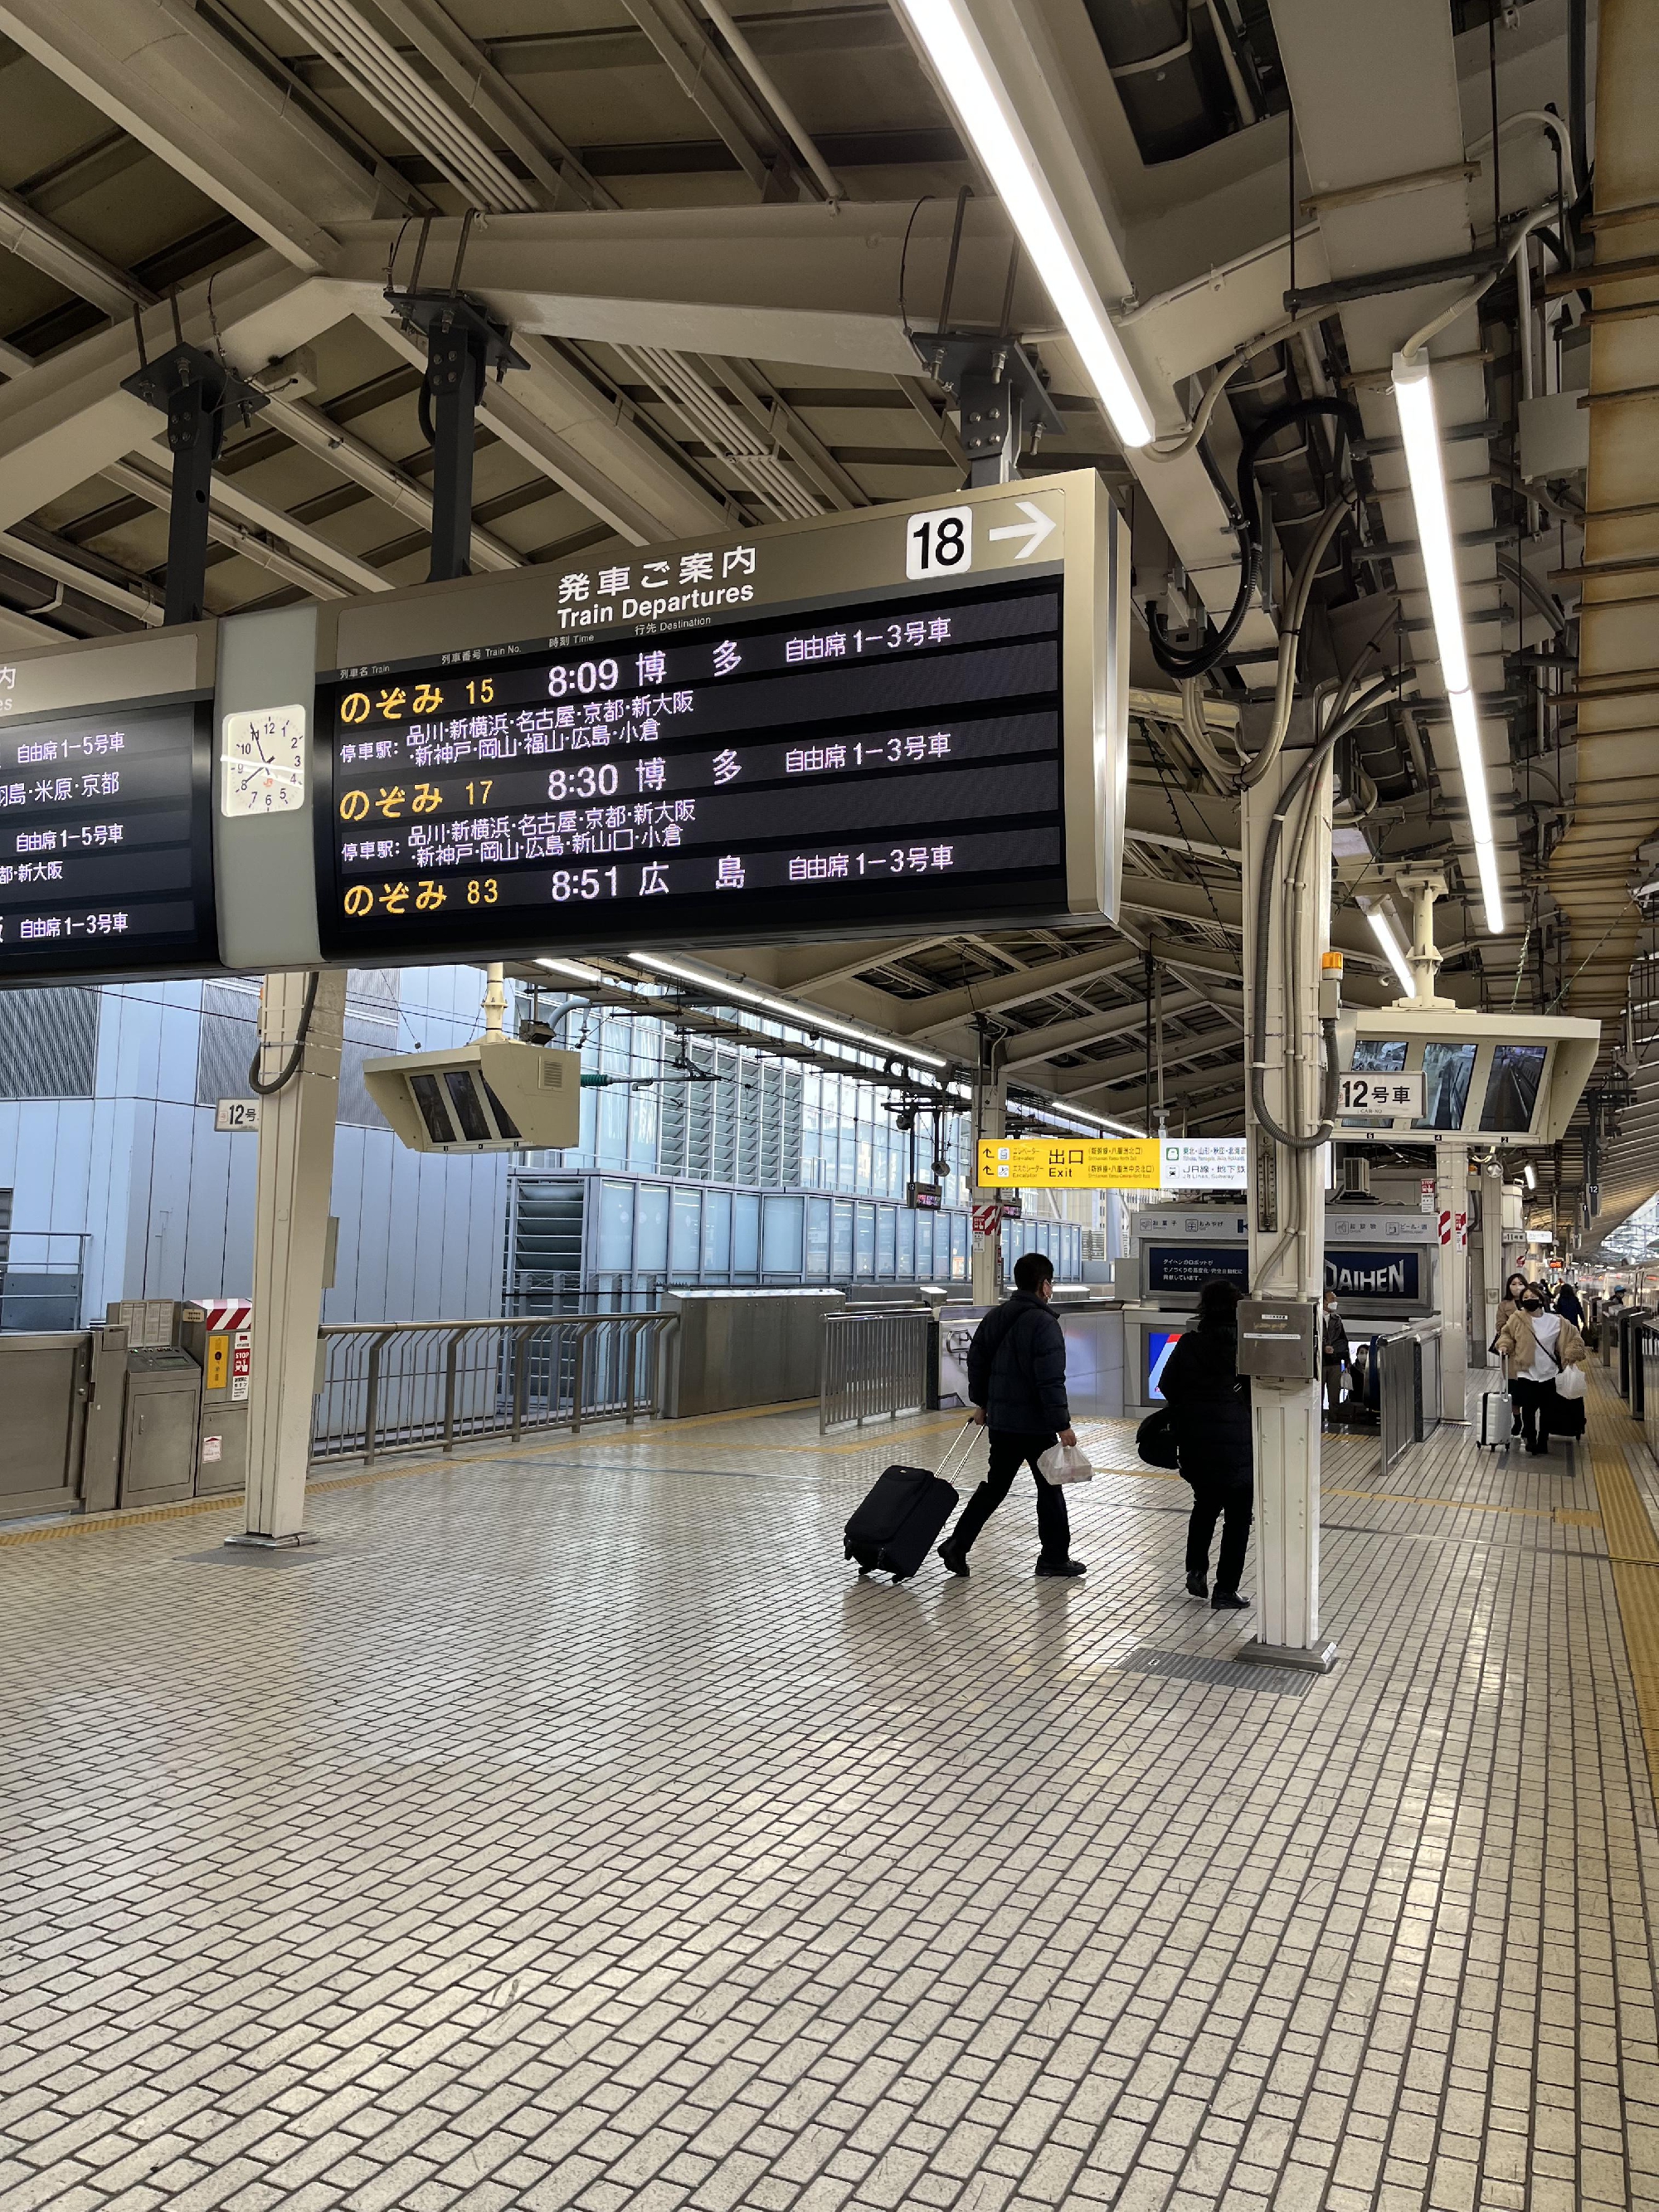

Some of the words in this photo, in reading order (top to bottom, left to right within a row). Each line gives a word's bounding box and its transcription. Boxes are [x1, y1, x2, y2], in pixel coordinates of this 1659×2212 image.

[912, 517, 966, 570] 18
[557, 545, 757, 604] 発車ご案内
[557, 603, 614, 629] Train
[621, 583, 754, 620] Departures
[634, 622, 657, 636] 行先
[659, 616, 712, 631] Destination
[548, 635, 570, 648] 時刻
[573, 634, 595, 645] Time
[440, 649, 482, 665] 列車番号
[484, 646, 506, 658] Train
[507, 645, 522, 655] No.
[339, 667, 368, 680] 列車名
[371, 664, 390, 675] Train
[340, 684, 445, 724] のぞみ
[465, 677, 494, 704] 15
[547, 658, 620, 698] 8:09
[264, 723, 275, 735] 12
[281, 726, 286, 738] 1
[241, 743, 251, 755] 10
[290, 737, 299, 749] 2
[237, 763, 244, 774] 9
[294, 755, 301, 767] 3
[241, 779, 247, 791] 8
[290, 772, 297, 784] 4
[251, 791, 258, 804] 7
[280, 787, 286, 800] 5
[339, 782, 443, 821] のぞみ
[465, 780, 494, 806] 17
[547, 763, 619, 801] 8:30
[265, 794, 272, 806] 6
[343, 880, 448, 917] のぞみ
[466, 878, 499, 904] 83
[552, 865, 617, 902] 8:51
[1342, 1080, 1411, 1108] 12号車
[228, 1104, 258, 1126] 12号
[1048, 1148, 1084, 1165] 出口
[1048, 1167, 1073, 1177] Exit
[1324, 1259, 1404, 1293] DAIHEN
